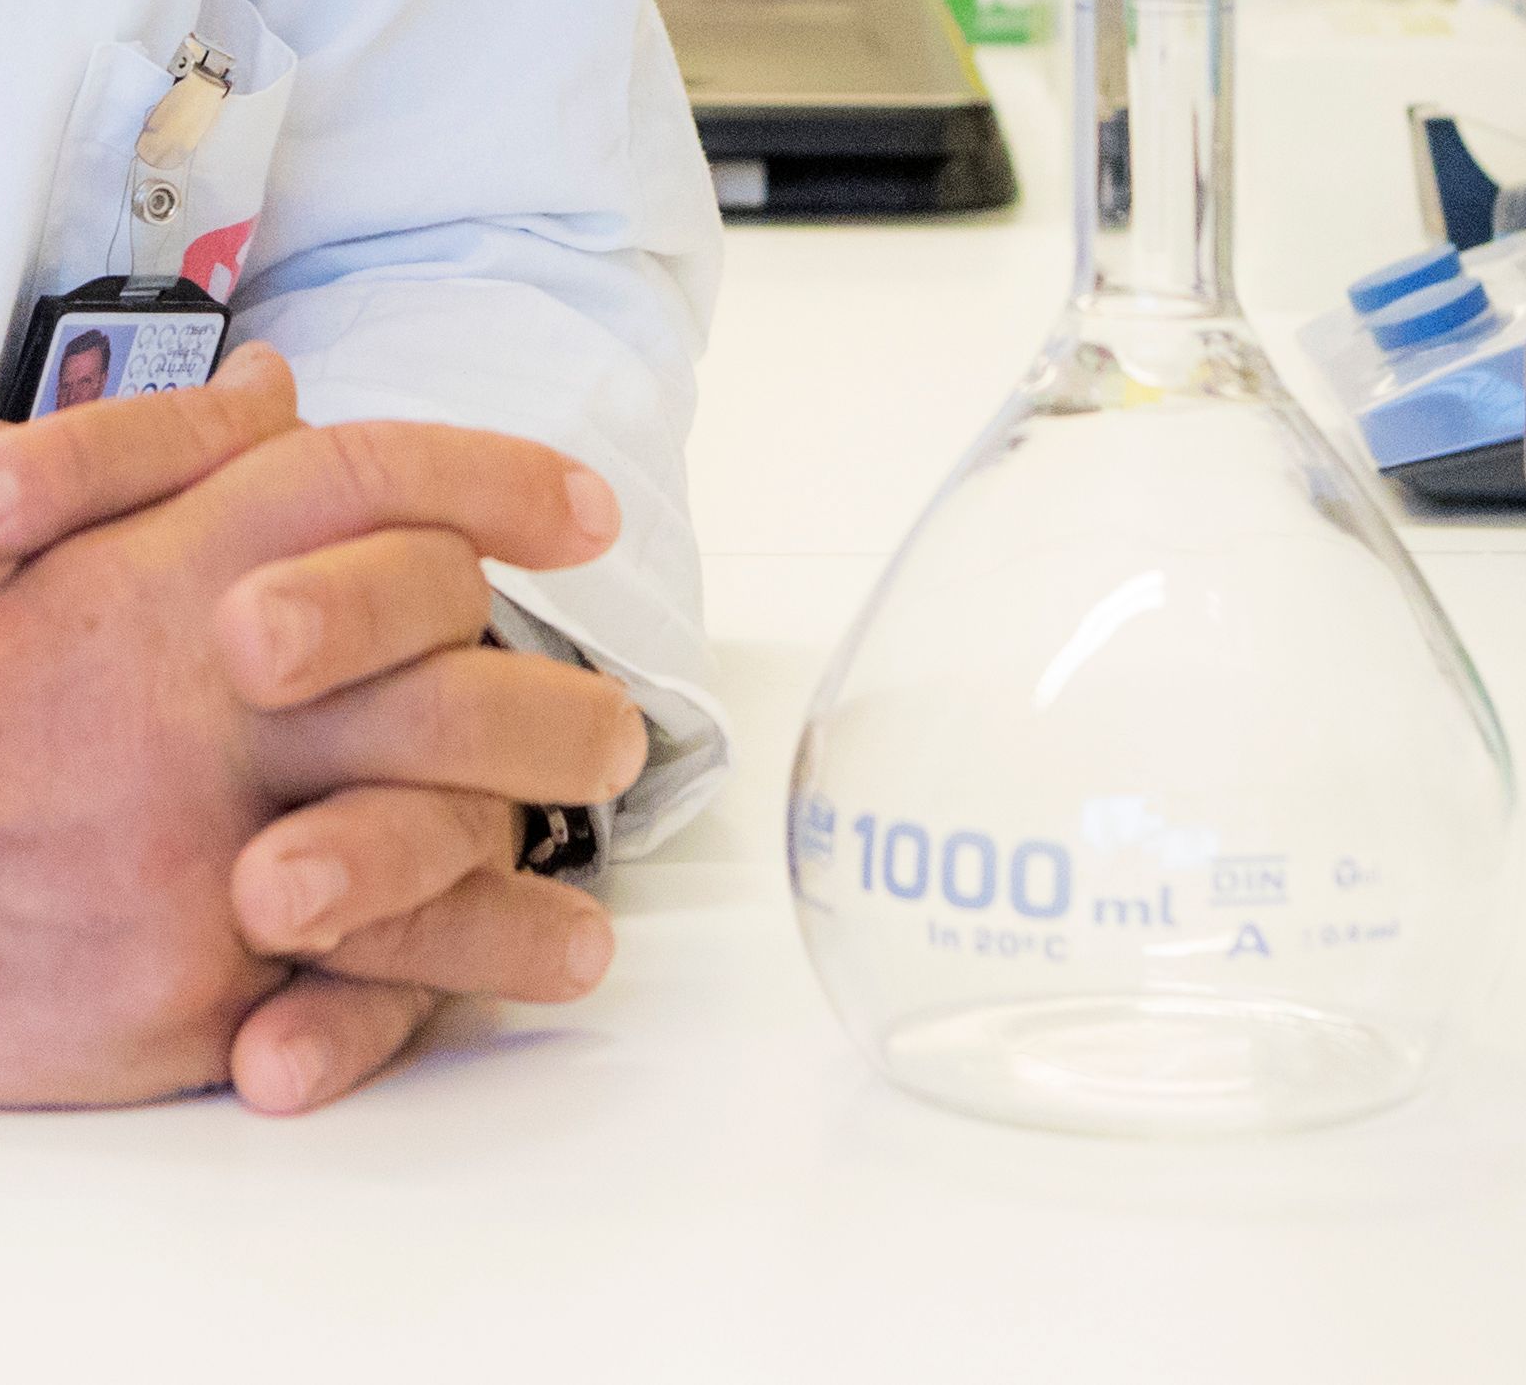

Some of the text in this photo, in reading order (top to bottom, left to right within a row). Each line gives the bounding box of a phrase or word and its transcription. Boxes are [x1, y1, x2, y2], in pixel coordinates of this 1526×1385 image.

[853, 813, 1072, 919] 1000
[1093, 884, 1177, 928] ml
[1225, 920, 1273, 960] A
